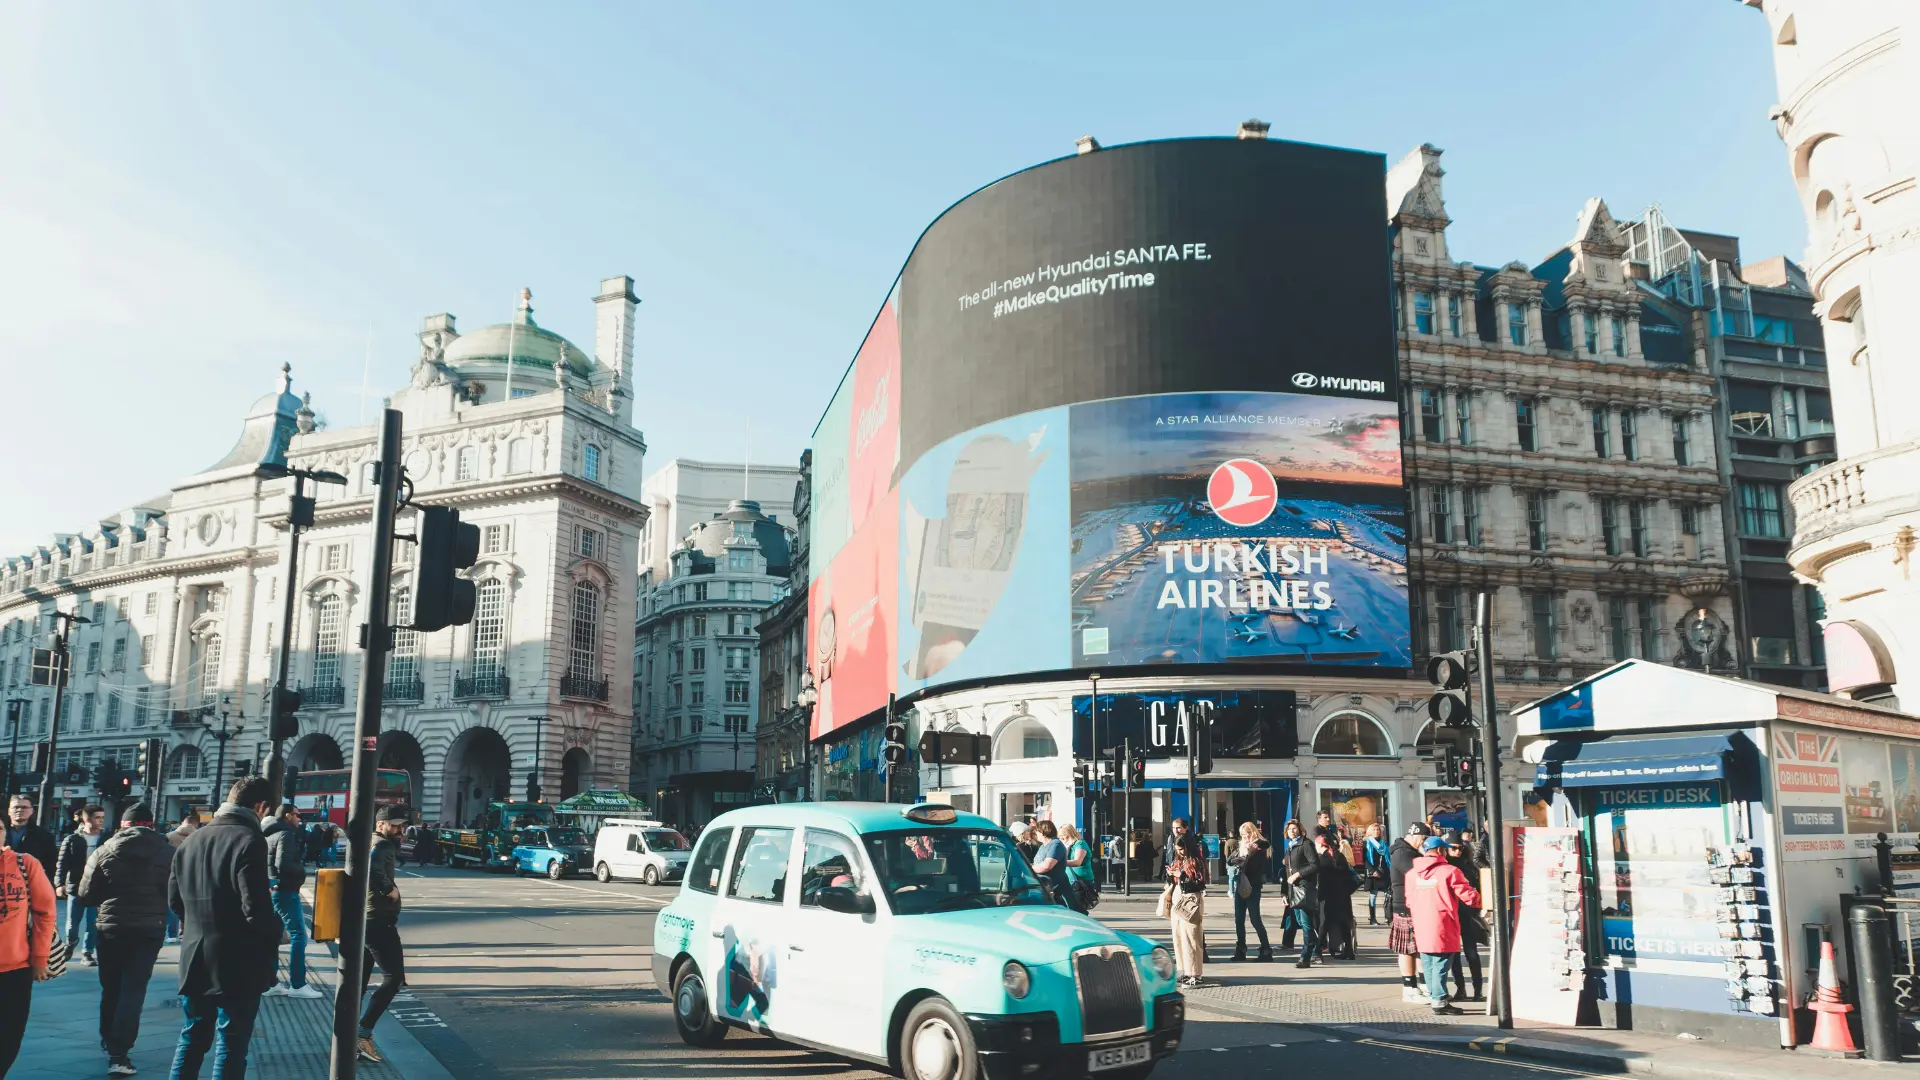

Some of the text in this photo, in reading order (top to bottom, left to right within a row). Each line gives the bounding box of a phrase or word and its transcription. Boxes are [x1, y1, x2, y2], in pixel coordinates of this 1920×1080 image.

[958, 243, 1212, 311] The all-new Hyundai SANTA FE.
[993, 272, 1155, 318] #MakeQualityTime
[1321, 376, 1385, 393] HYUNDAI
[1155, 414, 1321, 427] A STAR ALLIANCE MEMBER
[1157, 543, 1328, 576] TURKISH
[1156, 578, 1332, 612] AIRLINES
[1799, 740, 1816, 754] THE
[1780, 770, 1819, 786] ORIGINAL
[1600, 787, 1712, 804] TICKET DESK
[1792, 812, 1835, 825] TICKETS HERE
[661, 912, 695, 931] rightmove
[1607, 936, 1678, 954] TICKETS
[915, 946, 977, 966] rightmove
